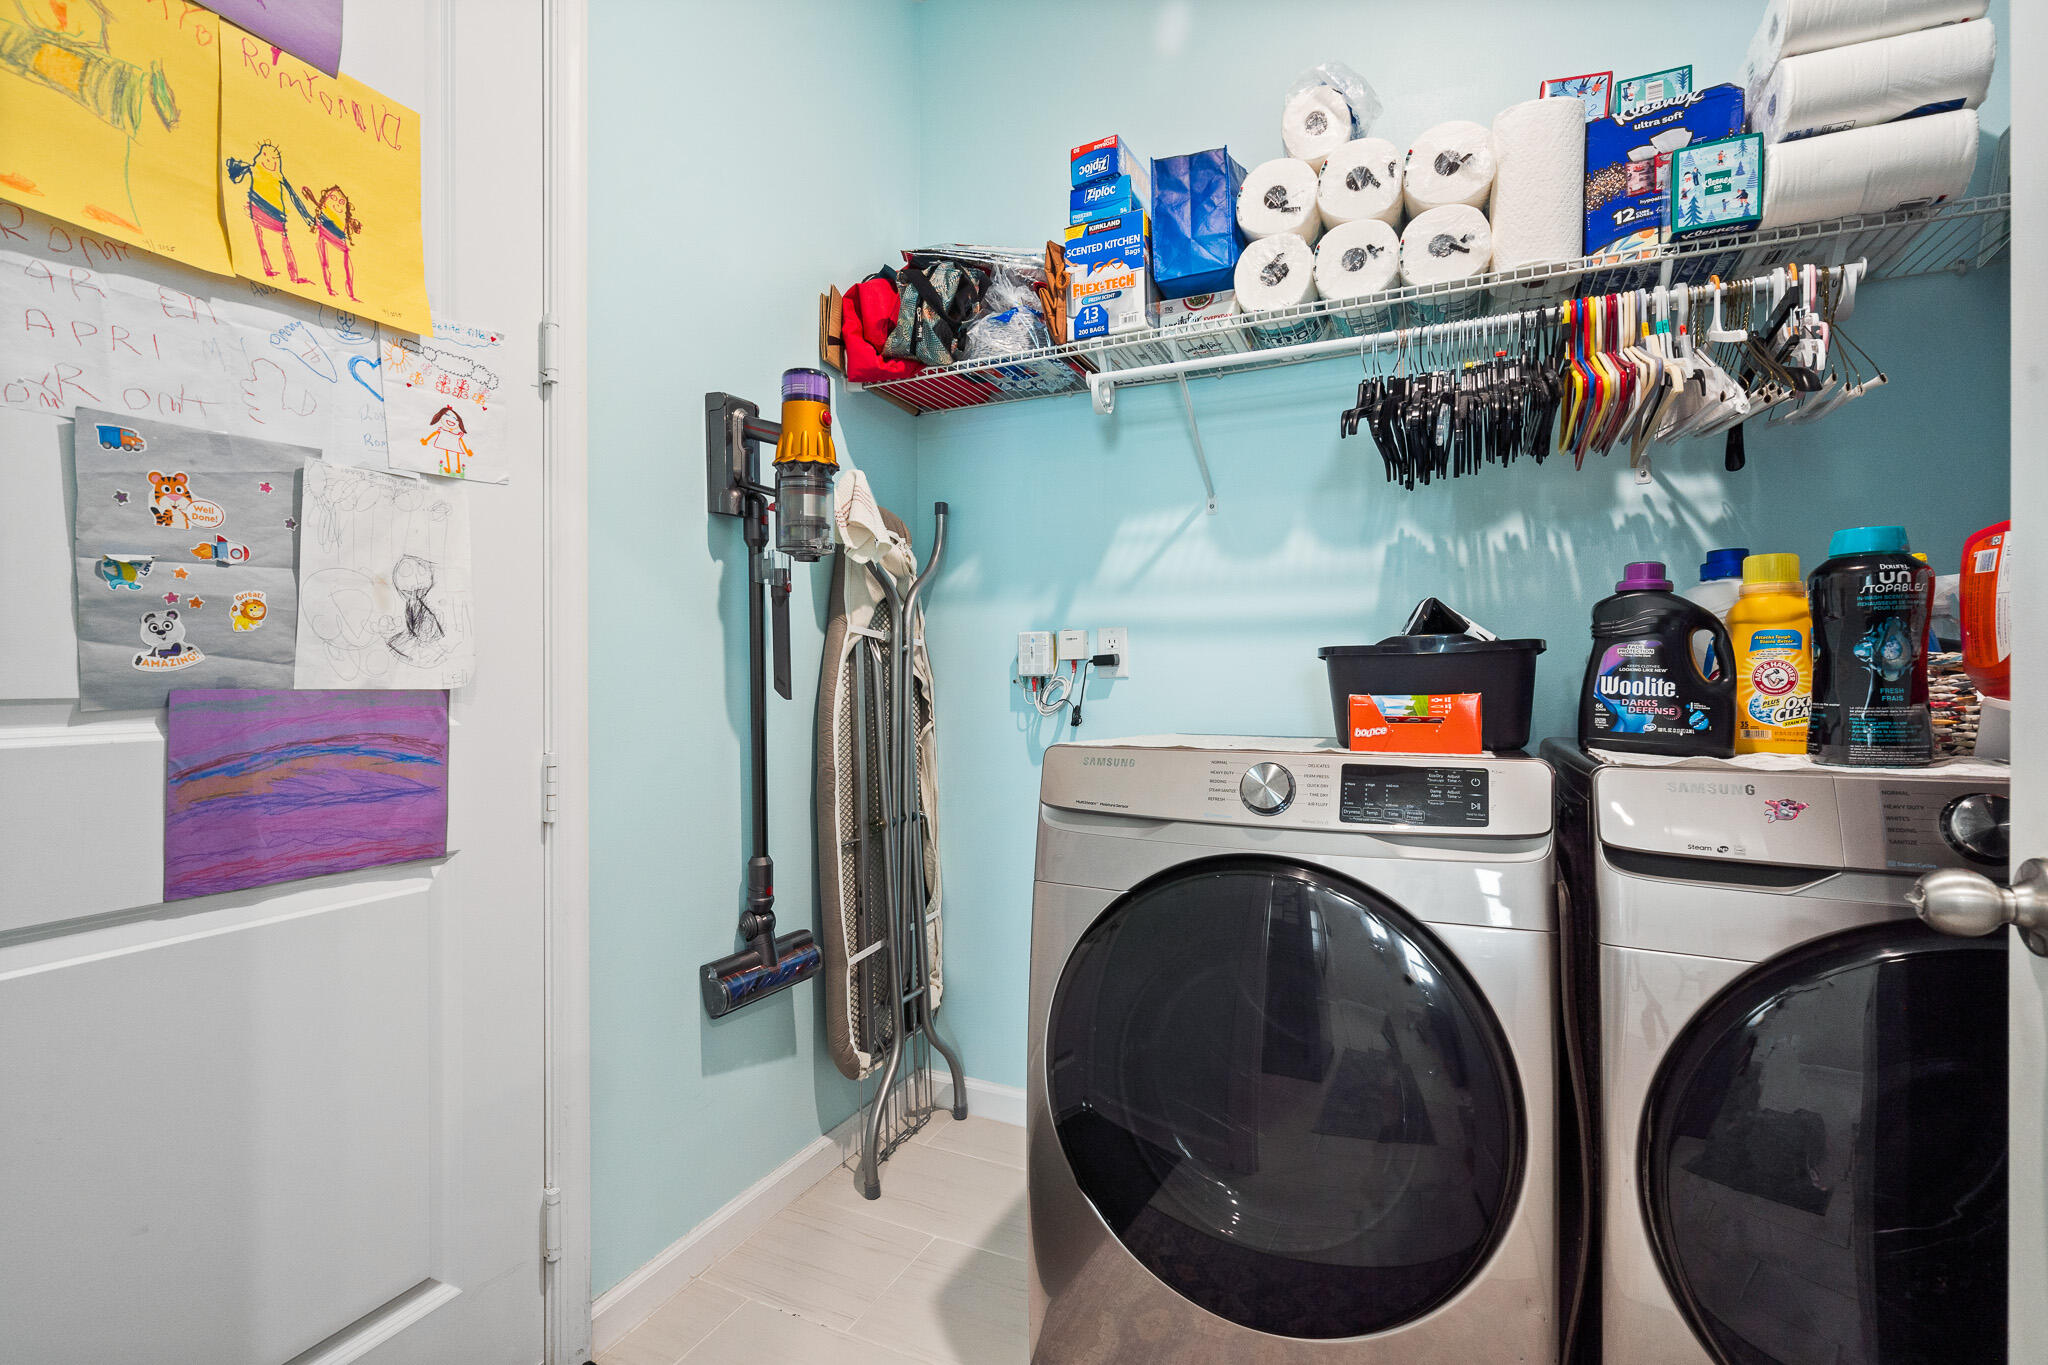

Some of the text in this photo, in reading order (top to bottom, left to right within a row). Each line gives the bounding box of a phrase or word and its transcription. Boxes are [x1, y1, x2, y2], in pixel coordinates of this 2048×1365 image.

[1611, 89, 1705, 127] Kleenex
[1633, 110, 1685, 131] ultra soft
[1078, 154, 1110, 177] Ziploc
[1083, 185, 1117, 204] Ziploc
[1612, 207, 1636, 226] 12
[1088, 219, 1121, 232] KIRKLAND
[1066, 233, 1141, 258] SCENTED KITCHEN
[1124, 247, 1141, 257] Bags
[1072, 273, 1136, 299] FLEX-TECH
[1083, 307, 1099, 321] 13
[1089, 325, 1105, 334] BAGS
[192, 504, 215, 515] Well
[191, 512, 219, 524] Done!
[141, 650, 201, 669] AMAZING!
[1762, 699, 1780, 708] PLUS
[1628, 706, 1676, 716] DEFENSE
[1774, 707, 1811, 723] CLEA
[1354, 726, 1388, 737] bounce
[1082, 756, 1136, 768] SAMSUNG
[1666, 782, 1756, 796] SAMSUNG
[1687, 843, 1712, 851] Steam
